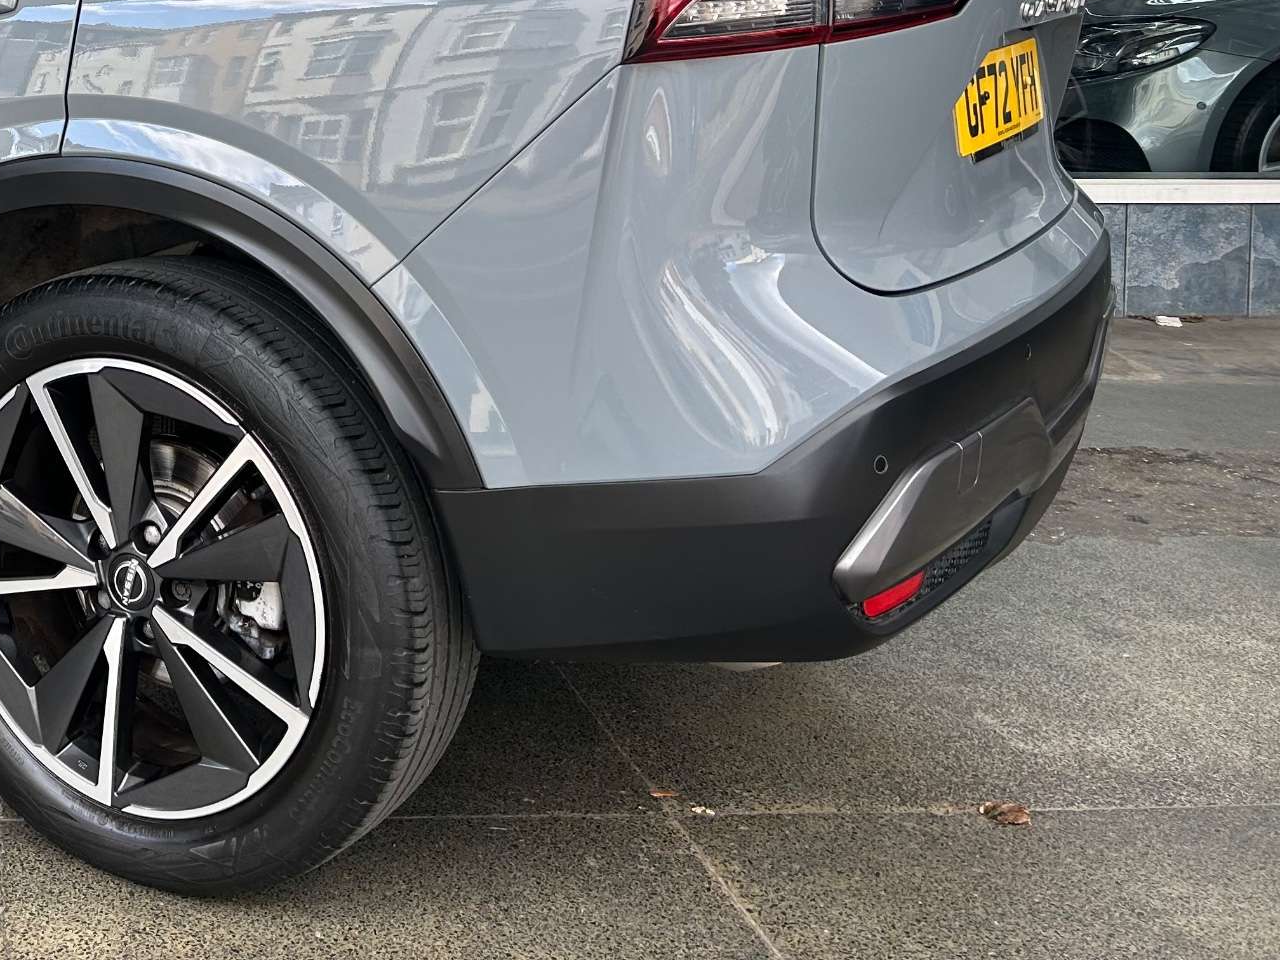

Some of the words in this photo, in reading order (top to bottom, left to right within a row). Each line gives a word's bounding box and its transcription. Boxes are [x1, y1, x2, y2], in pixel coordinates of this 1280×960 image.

[964, 60, 1013, 138] GF72
[1010, 50, 1039, 118] YFH
[121, 558, 139, 607] NISSAN
